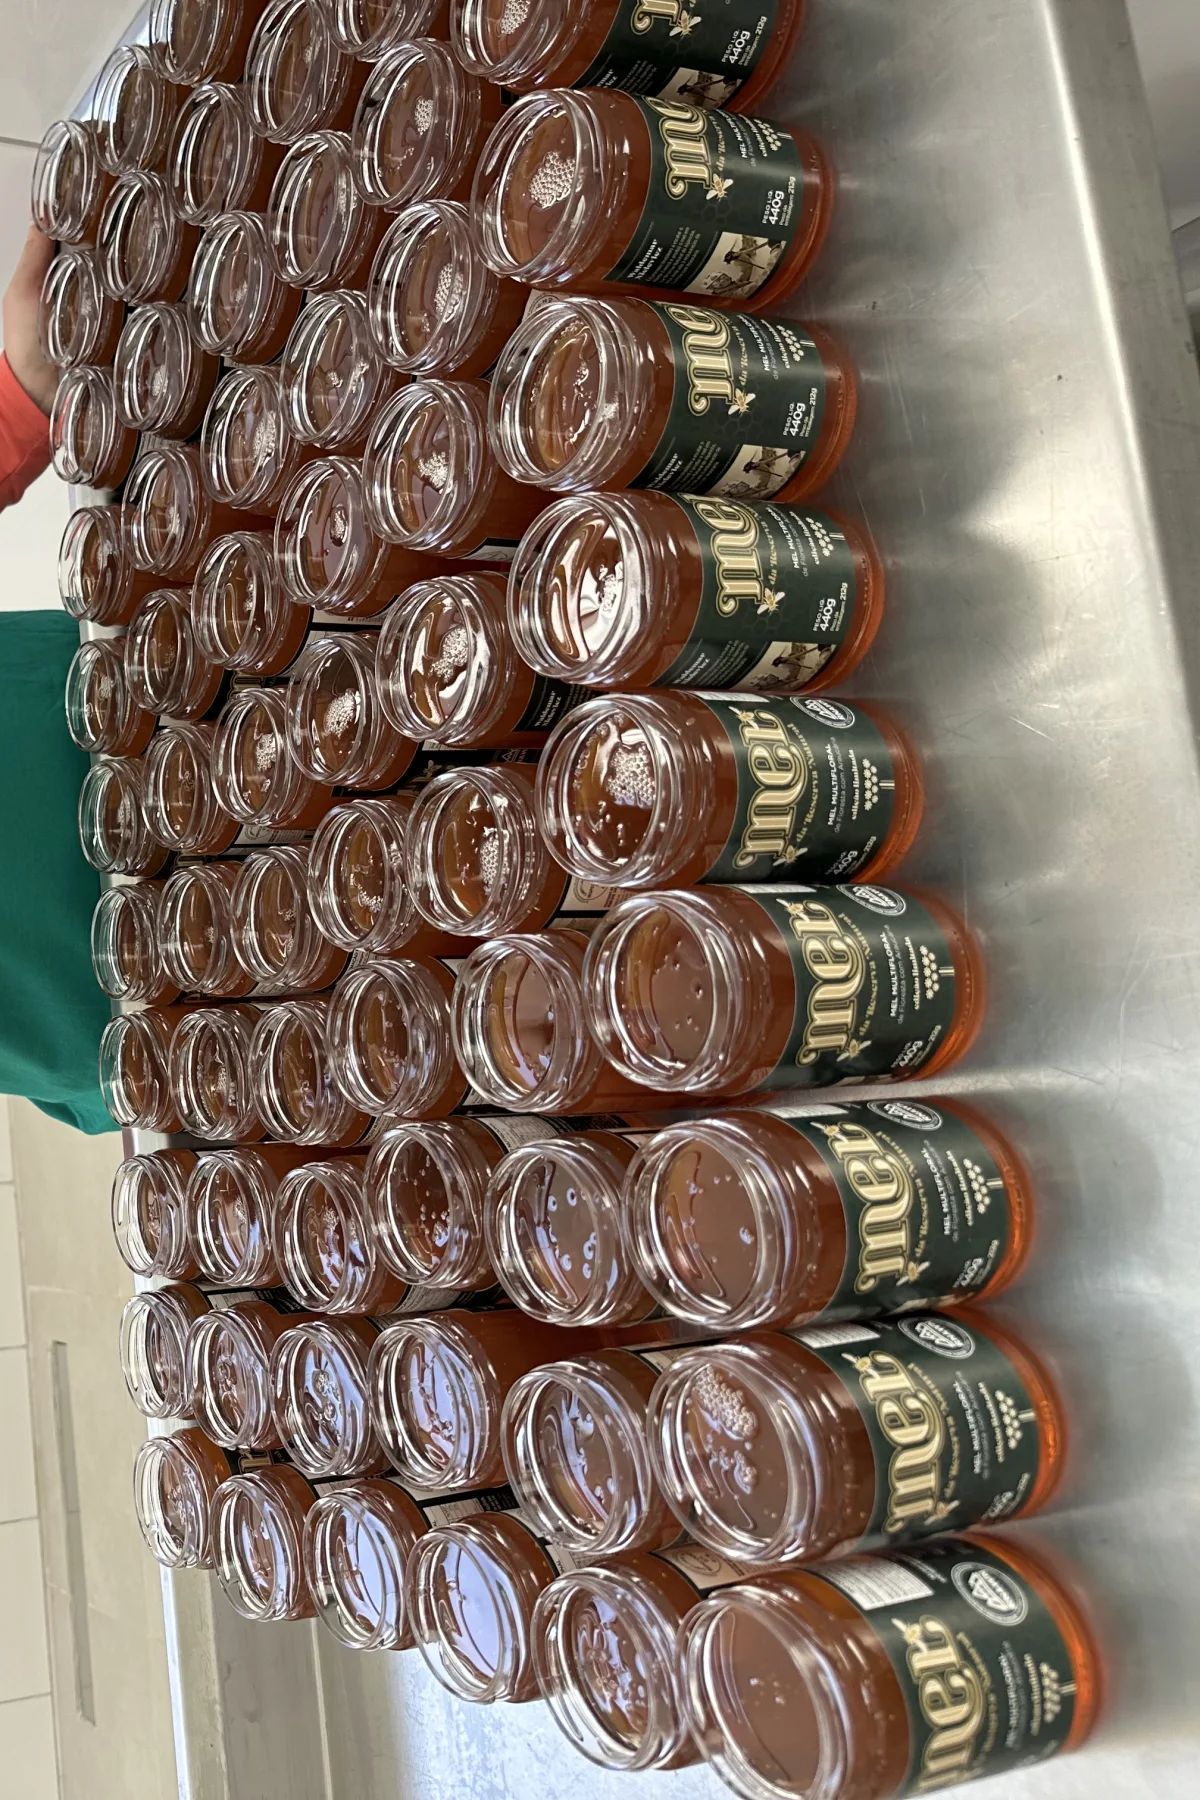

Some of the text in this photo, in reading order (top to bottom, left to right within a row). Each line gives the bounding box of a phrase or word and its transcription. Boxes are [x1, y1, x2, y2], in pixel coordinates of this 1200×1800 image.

[755, 16, 767, 35] 212g
[721, 29, 740, 62] PESO LIQ.
[729, 30, 751, 63] 440g
[709, 116, 725, 171] da Reserva
[739, 142, 748, 158] MEL
[751, 132, 768, 156] edição
[749, 157, 756, 167] de
[788, 176, 796, 194] 212g
[761, 205, 771, 223] PESO
[768, 190, 784, 224] 440g
[778, 213, 786, 226] Peso
[627, 239, 657, 279] Waldemar
[731, 326, 748, 385] da Reserva
[762, 354, 770, 371] MEL
[765, 342, 777, 368] Floresta
[777, 343, 790, 368] edição
[771, 369, 779, 380] de
[809, 387, 817, 405] 212g
[782, 418, 792, 435] PESO
[789, 402, 806, 437] 440g
[765, 506, 796, 550] MULTIFLORAL
[760, 521, 778, 584] da Reserva
[791, 551, 800, 569] MEL
[795, 538, 807, 566] Floresta
[807, 537, 820, 565] edição
[802, 567, 809, 577] de
[839, 582, 848, 600] 212g
[812, 613, 822, 631] PESO
[819, 598, 837, 631] 440g
[787, 723, 818, 842] da Reserva Natural
[825, 744, 838, 825] MEL MULTIFLORAL
[829, 737, 846, 833] de Floresta com Araucária
[848, 749, 860, 820] edição limitada
[838, 912, 878, 1035] da Reserva Natural
[880, 932, 898, 1017] MEL MULTIFLORAL
[883, 924, 906, 1024] de Floresta com Araucária
[904, 936, 921, 1010] edição limitada
[921, 1147, 951, 1235] MEL MULTIFLORAL
